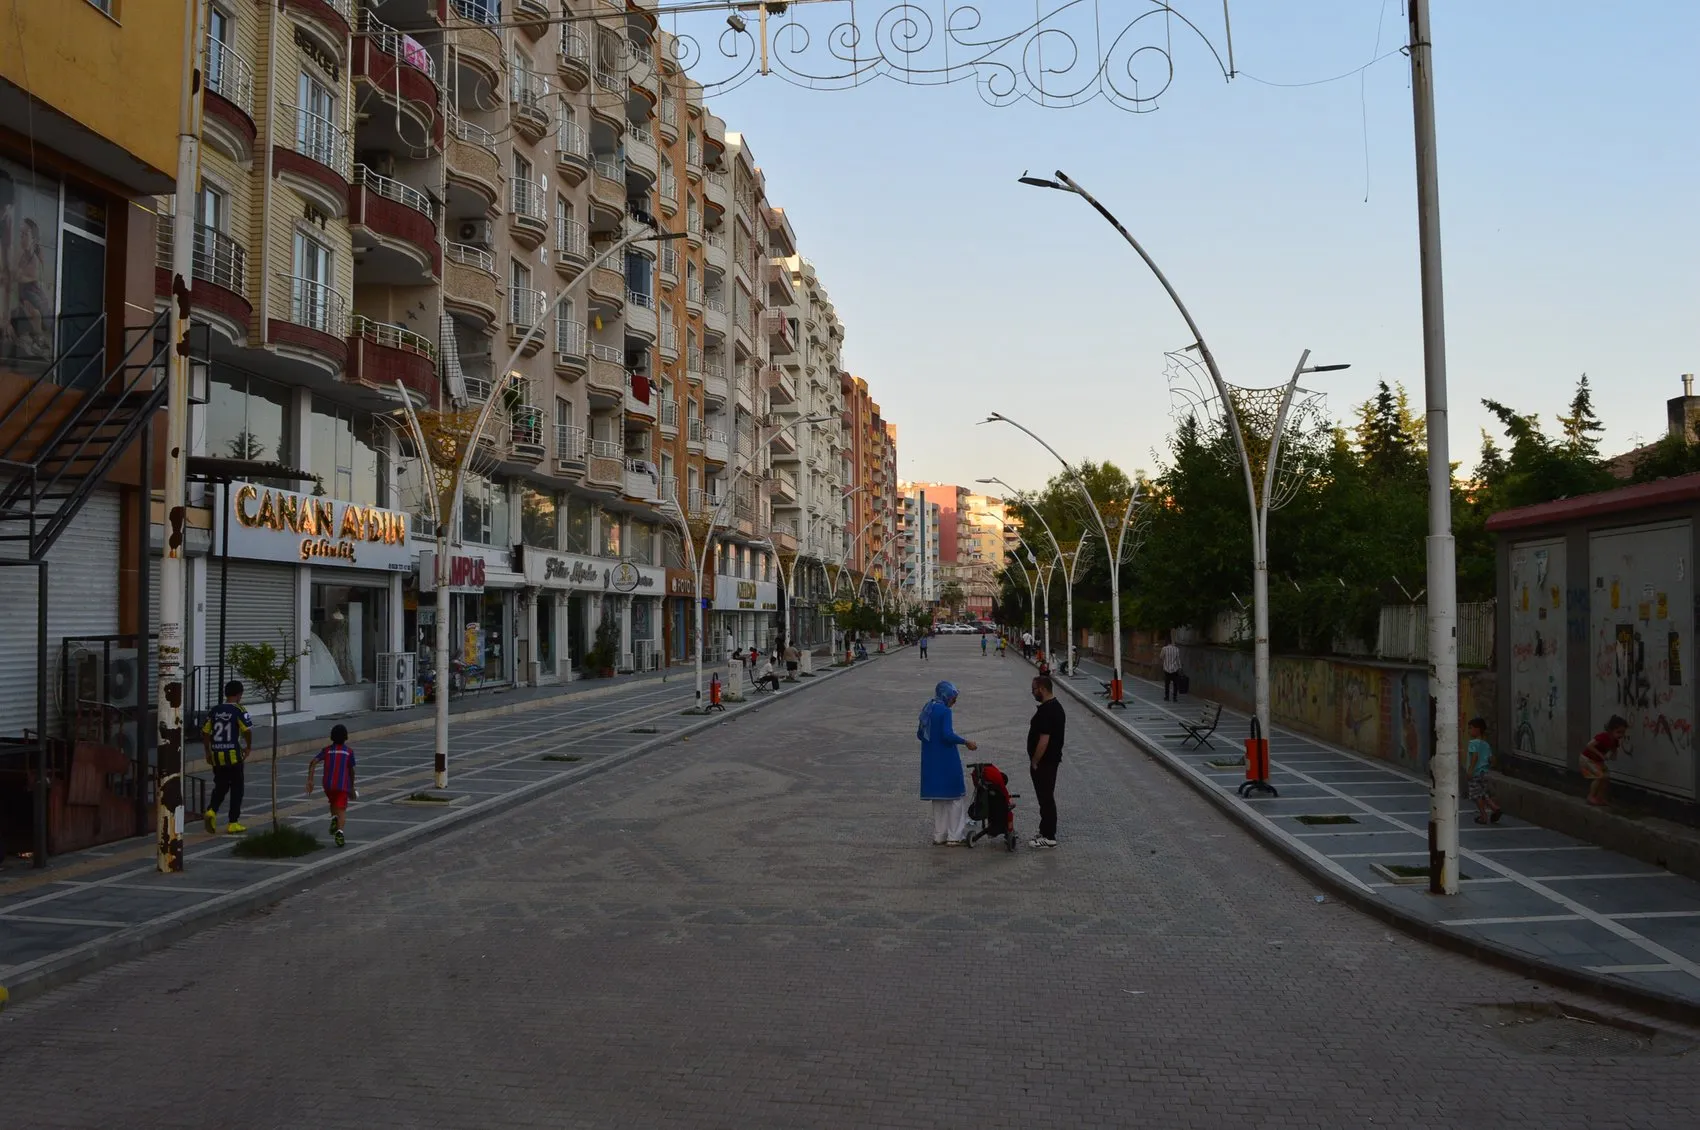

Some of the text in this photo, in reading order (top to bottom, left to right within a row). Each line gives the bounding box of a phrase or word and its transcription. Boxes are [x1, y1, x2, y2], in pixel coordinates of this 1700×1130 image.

[234, 484, 406, 548] CANAN AYDIN
[300, 538, 357, 563] Gelinlik
[677, 578, 691, 594] FOTO
[213, 722, 232, 742] 21
